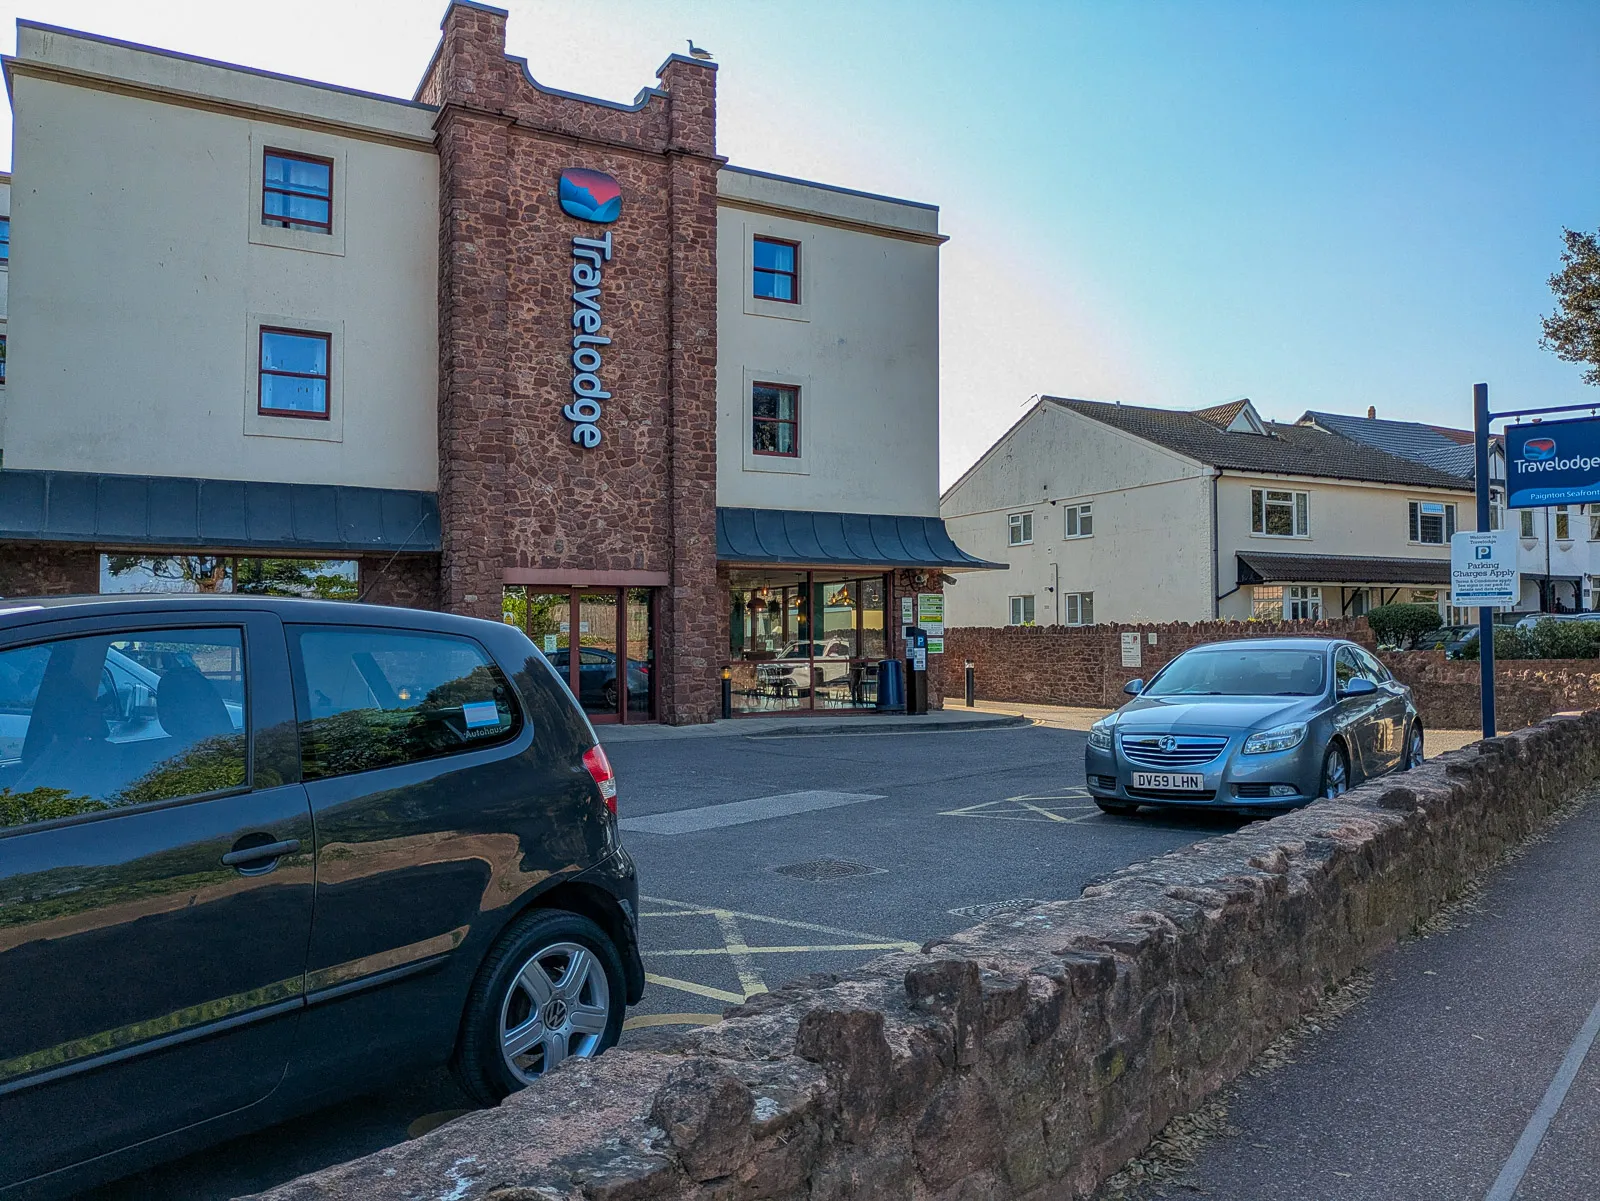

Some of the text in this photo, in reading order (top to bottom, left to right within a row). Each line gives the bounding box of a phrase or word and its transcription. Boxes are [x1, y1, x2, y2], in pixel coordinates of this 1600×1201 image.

[563, 231, 612, 450] Travelodge
[1513, 454, 1600, 474] Travelodge
[1530, 489, 1600, 500] Paignton Seafront
[1477, 547, 1490, 559] P
[1467, 562, 1500, 570] Parking
[1452, 569, 1516, 578] Charges Apply
[1138, 774, 1199, 788] DV59 LHN
